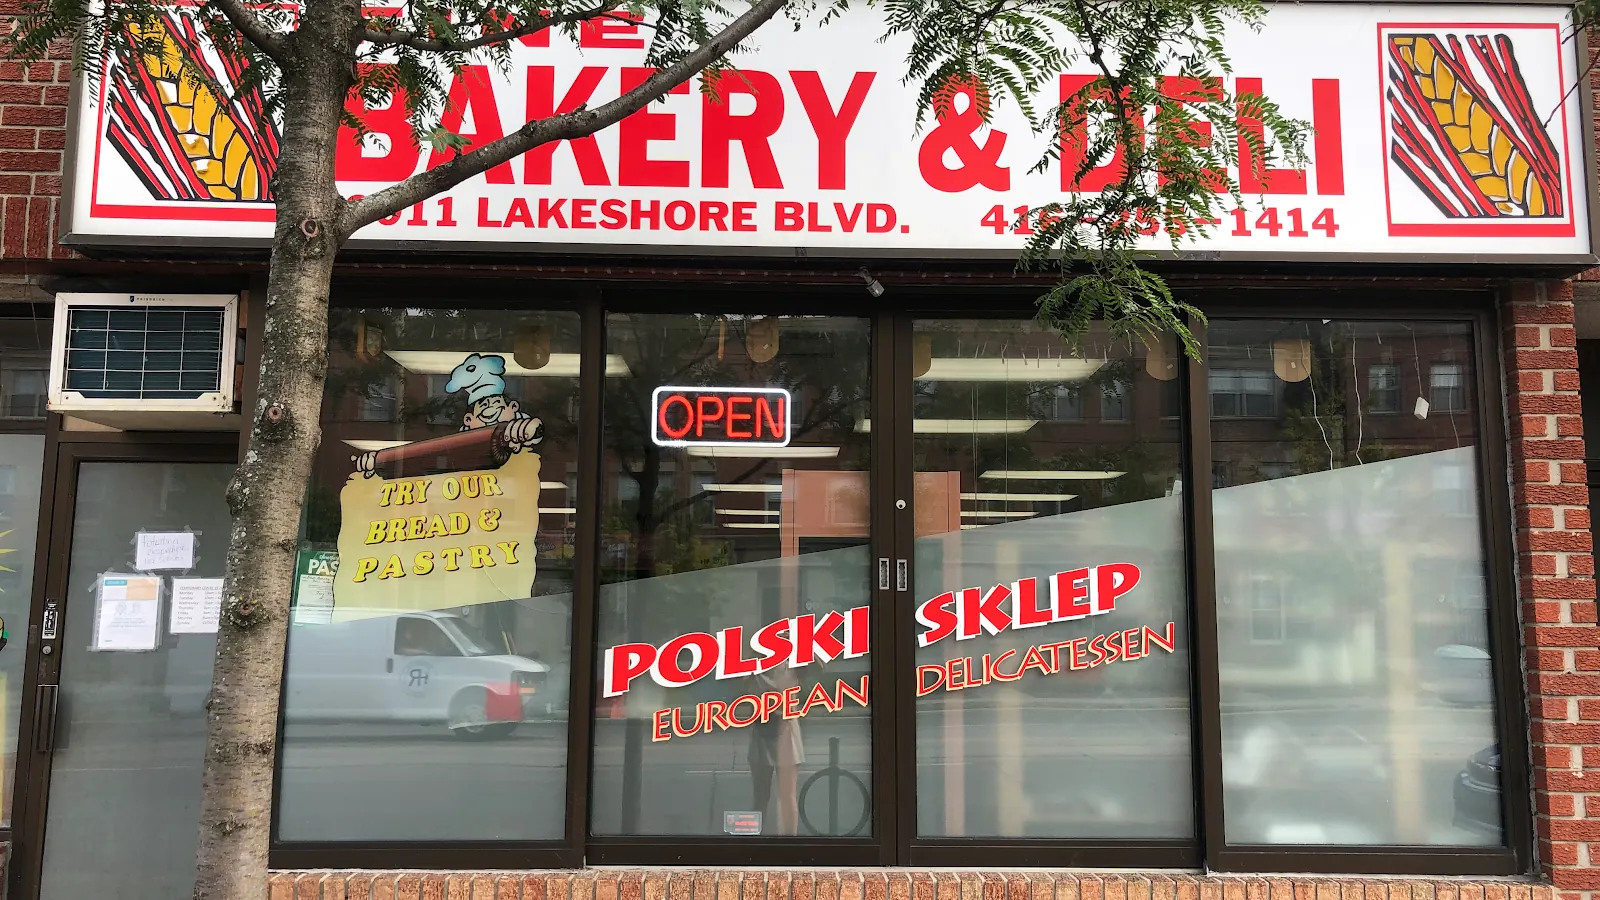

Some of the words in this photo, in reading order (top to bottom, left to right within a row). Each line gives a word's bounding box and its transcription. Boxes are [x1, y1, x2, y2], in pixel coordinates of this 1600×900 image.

[333, 62, 877, 190] BAKERY
[918, 73, 1011, 193] &
[1059, 74, 1345, 195] DELI
[347, 194, 457, 227] 11
[477, 197, 757, 232] LAKESHORE
[774, 201, 910, 234] BLVD.
[658, 394, 784, 439] OPEN
[379, 479, 433, 507] TRY
[442, 474, 503, 500] OUR
[364, 512, 471, 545] BREAD
[478, 508, 502, 531] &
[353, 541, 520, 583] PASTRY
[602, 605, 870, 698] POLSKI
[914, 562, 1142, 648] SKLEP
[652, 675, 870, 742] EUROPEAN
[915, 621, 1175, 697] DELICATESSEN
